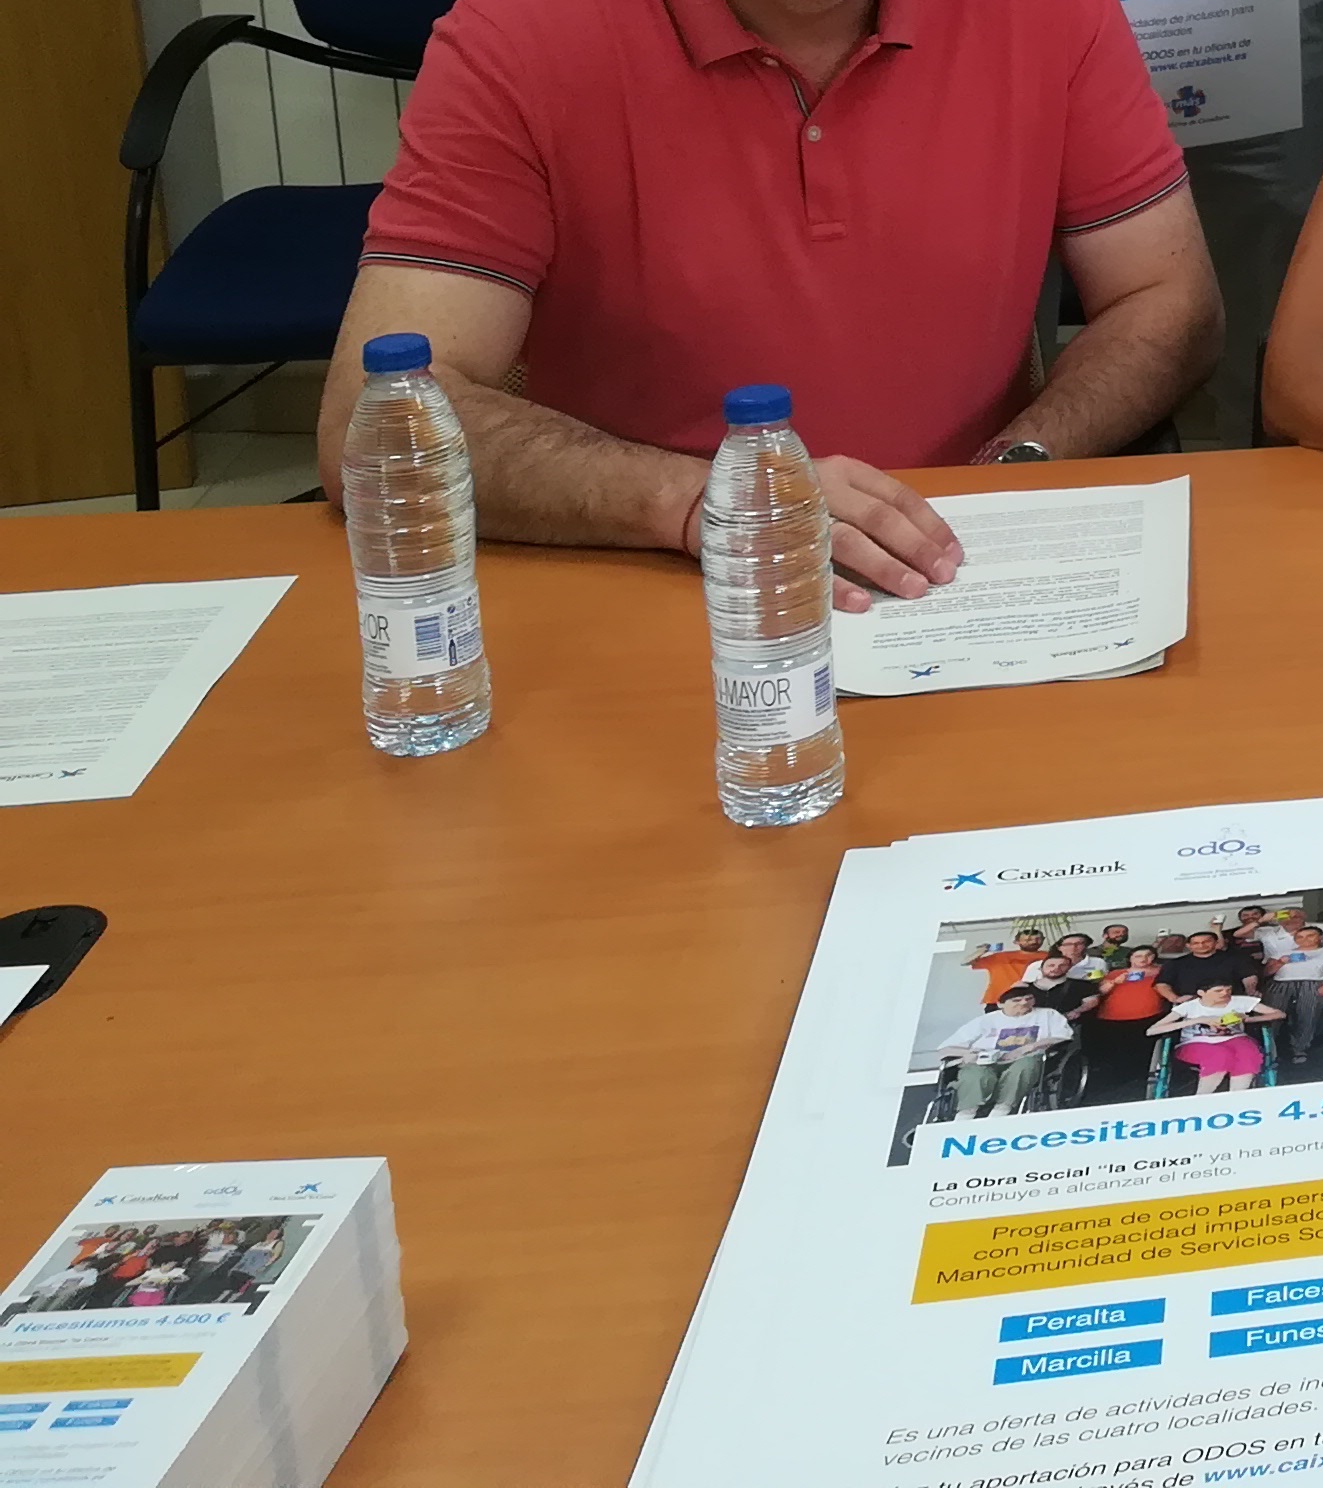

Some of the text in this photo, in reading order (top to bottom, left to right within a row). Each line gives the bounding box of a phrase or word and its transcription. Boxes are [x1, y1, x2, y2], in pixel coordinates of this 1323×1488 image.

[996, 859, 1126, 881] CaixaBank
[940, 1109, 1263, 1159] Necesitamos
[931, 1152, 1203, 1193] La Obra Social "la Caixa"
[992, 1217, 1111, 1240] Programa
[1120, 1211, 1151, 1225] de
[1158, 1204, 1210, 1221] ocio
[1218, 1198, 1271, 1217] para
[936, 1248, 1132, 1284] Mancomunidad
[1140, 1246, 1172, 1260] de
[1180, 1232, 1290, 1256] Servicios
[972, 1246, 1019, 1261] con
[1028, 1222, 1196, 1254] discapacidad
[1026, 1307, 1126, 1333] Peralta
[1020, 1347, 1131, 1376] Marcilla
